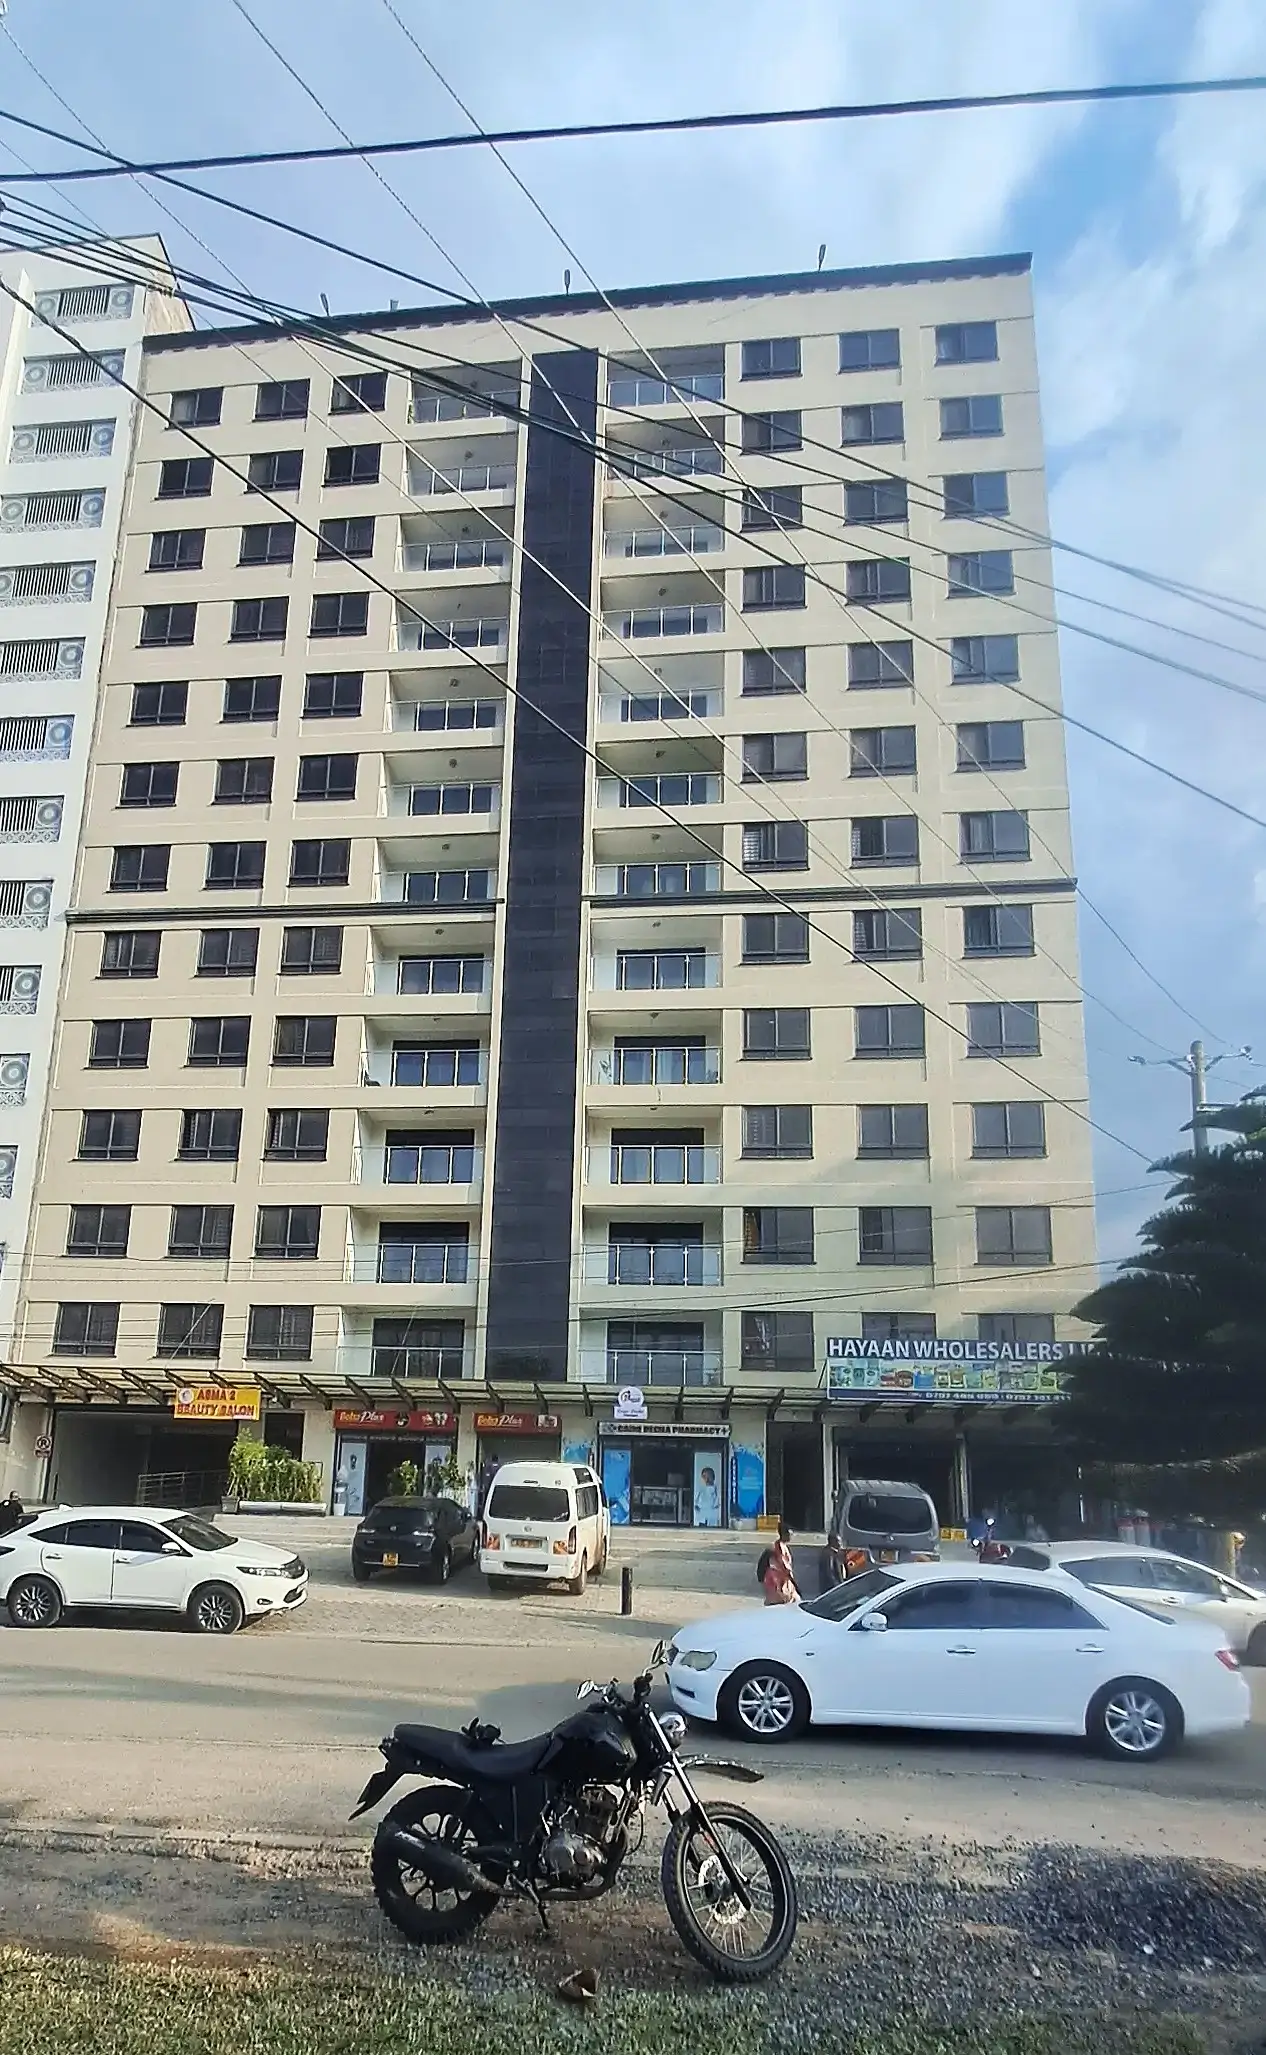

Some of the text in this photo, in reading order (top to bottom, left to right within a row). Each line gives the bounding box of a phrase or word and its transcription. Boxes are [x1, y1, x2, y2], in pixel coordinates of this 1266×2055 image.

[829, 1339, 909, 1358] HAYAAN
[913, 1340, 1064, 1360] WHOLESALERS
[229, 1390, 236, 1401] 2
[177, 1404, 255, 1417] BEAUTY SALON
[672, 1426, 720, 1434] PHARMACY
